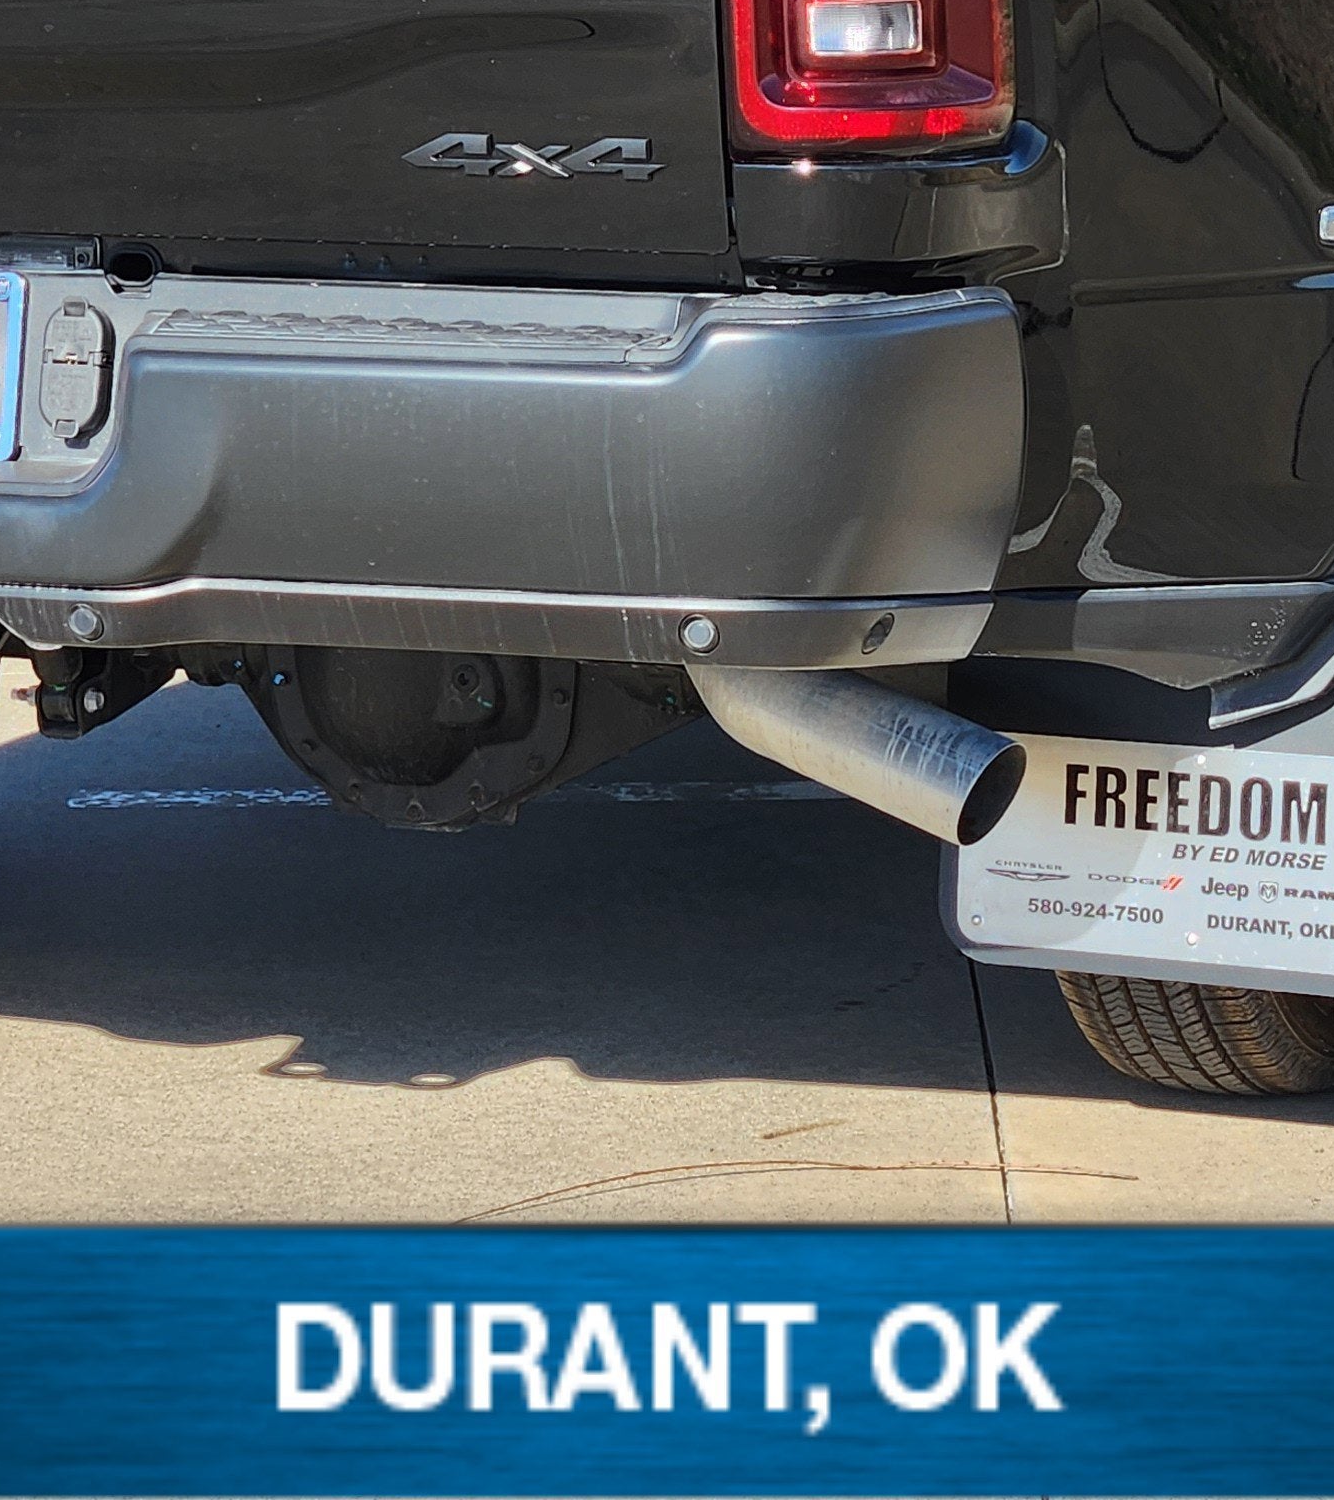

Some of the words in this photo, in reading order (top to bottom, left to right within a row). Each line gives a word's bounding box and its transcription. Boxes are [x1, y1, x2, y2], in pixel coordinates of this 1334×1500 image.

[400, 131, 667, 182] 4x4
[1064, 763, 1328, 846] FREEDOM
[1171, 844, 1205, 861] BY
[1208, 846, 1240, 864] ED
[1244, 848, 1328, 871] MORSE
[995, 859, 1064, 871] CHRYSLER
[1087, 872, 1167, 886] DODGE
[1201, 876, 1250, 902] Jeep
[1028, 897, 1164, 924] 580-924-7500
[1206, 913, 1294, 939] DURANT,
